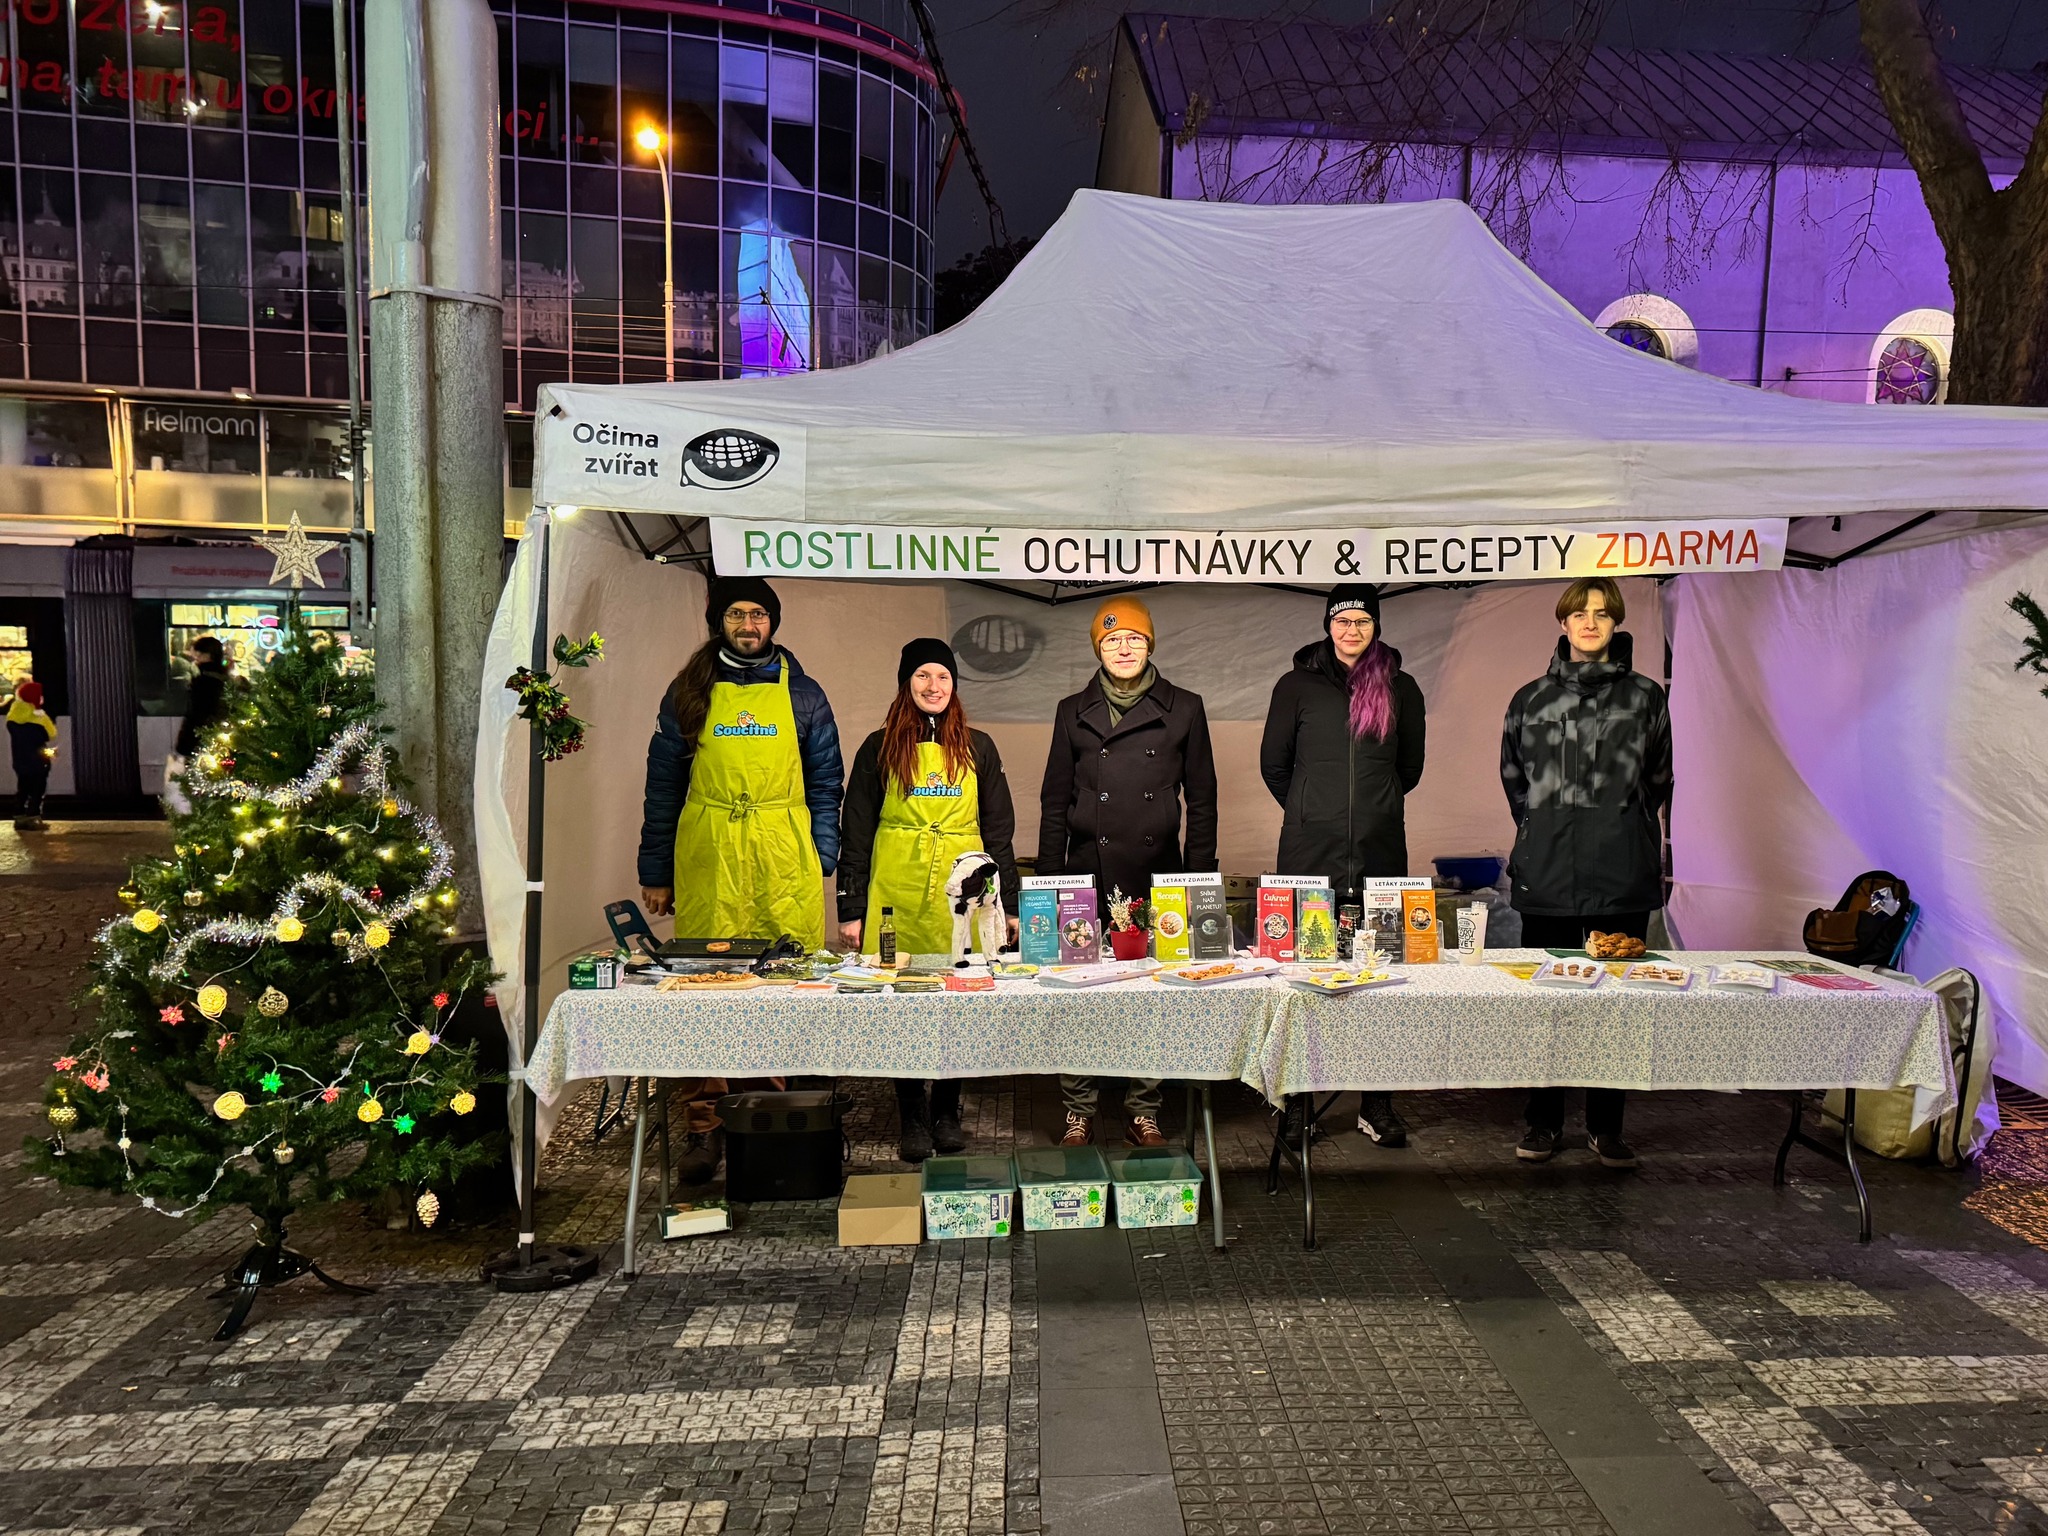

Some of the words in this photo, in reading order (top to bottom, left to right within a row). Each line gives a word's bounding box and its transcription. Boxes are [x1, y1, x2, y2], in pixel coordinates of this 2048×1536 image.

[573, 423, 659, 449] Očima
[585, 452, 659, 478] zvířat
[744, 527, 1000, 572] ROSTLINNÉ
[1024, 530, 1312, 576] OCHUTNÁVKY
[1334, 538, 1361, 576] &
[1386, 534, 1575, 576] RECEPTY
[1596, 529, 1760, 569] ZDARMA
[713, 723, 778, 737] Soucitně
[991, 1197, 999, 1219] vegan
